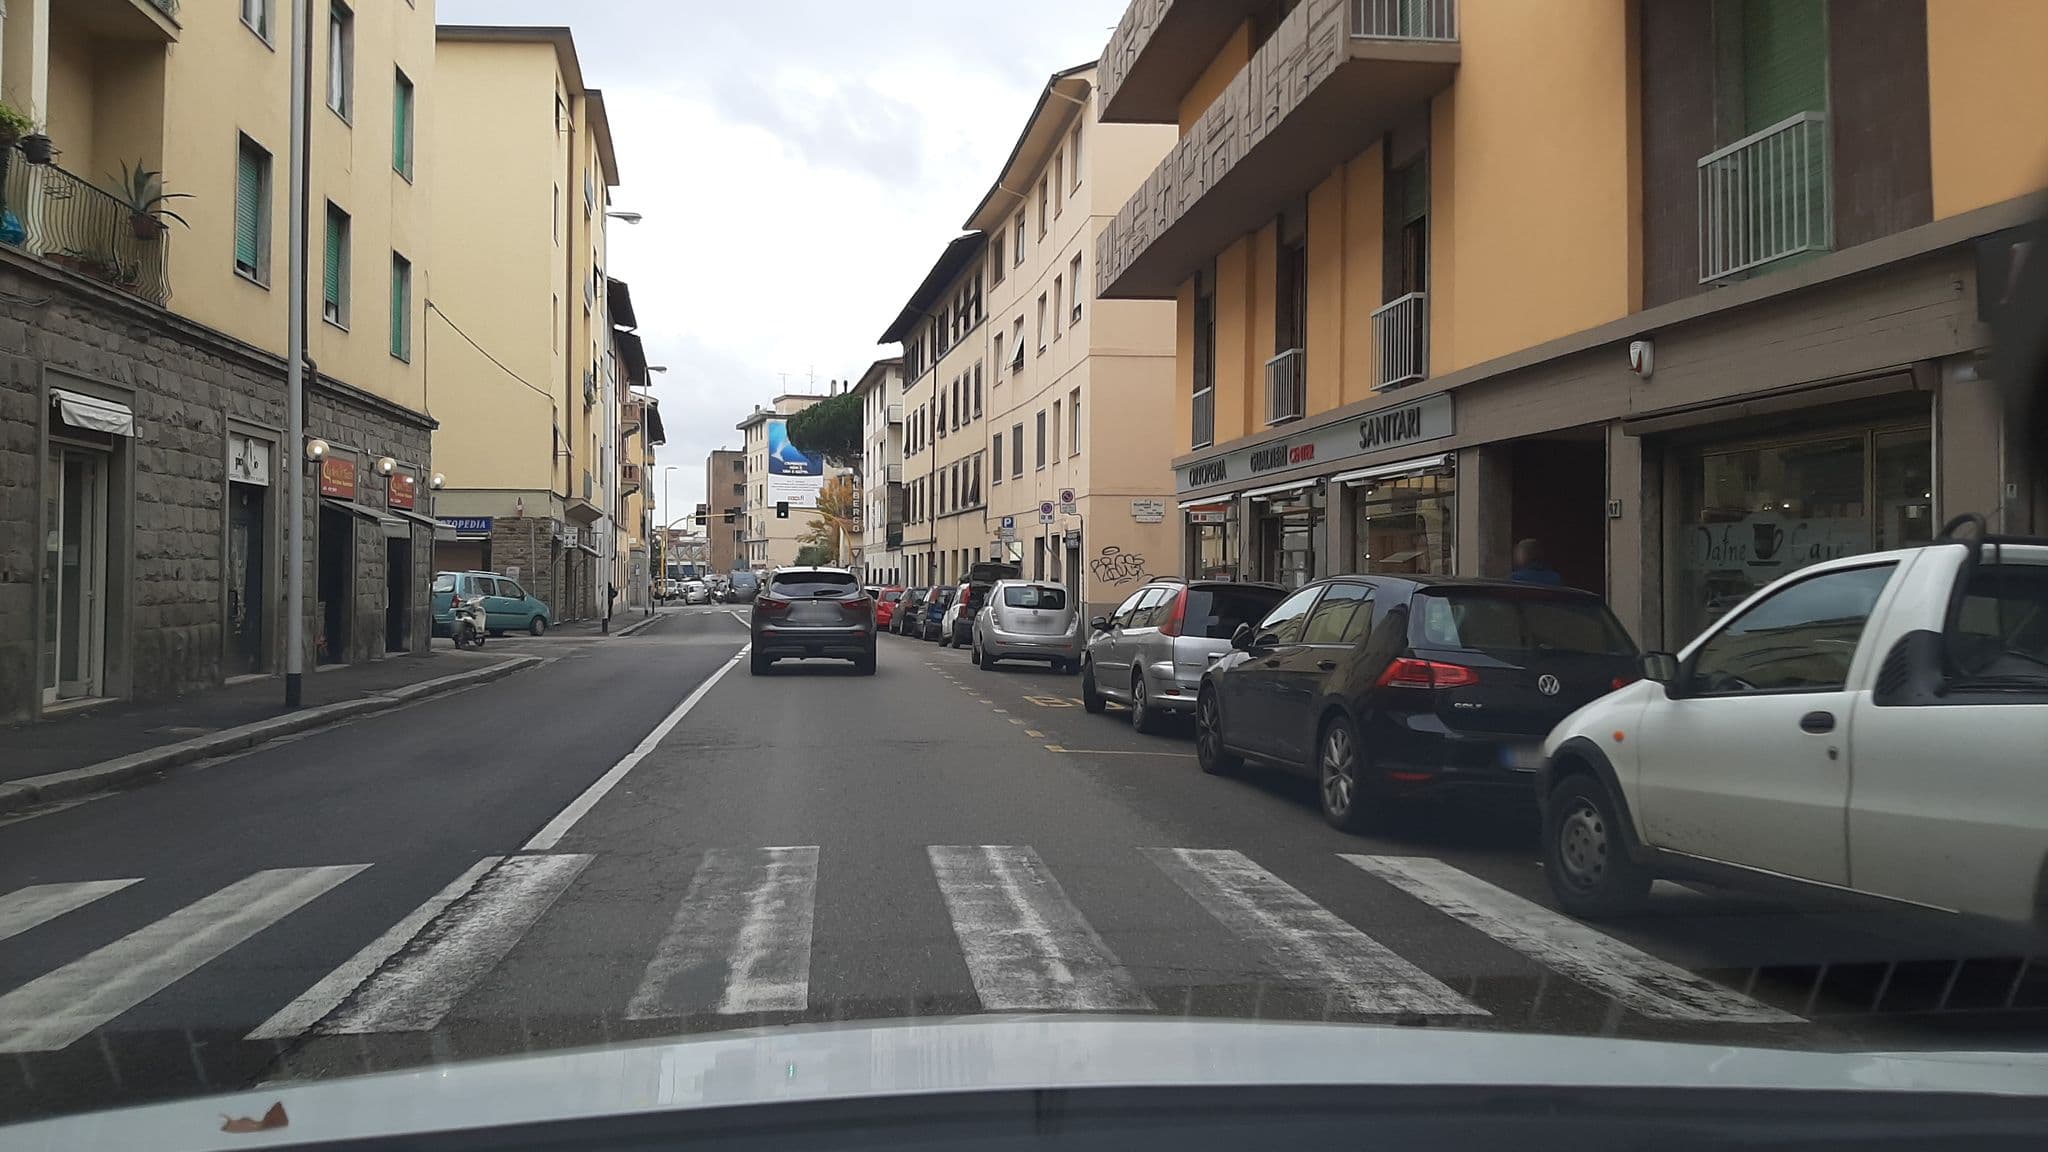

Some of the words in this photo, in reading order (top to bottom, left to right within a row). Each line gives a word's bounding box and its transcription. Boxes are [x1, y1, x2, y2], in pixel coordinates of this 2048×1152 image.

[1359, 406, 1421, 449] SANITARI
[1188, 459, 1228, 487] ORTOPEDIA
[852, 475, 860, 533] ALBERGO
